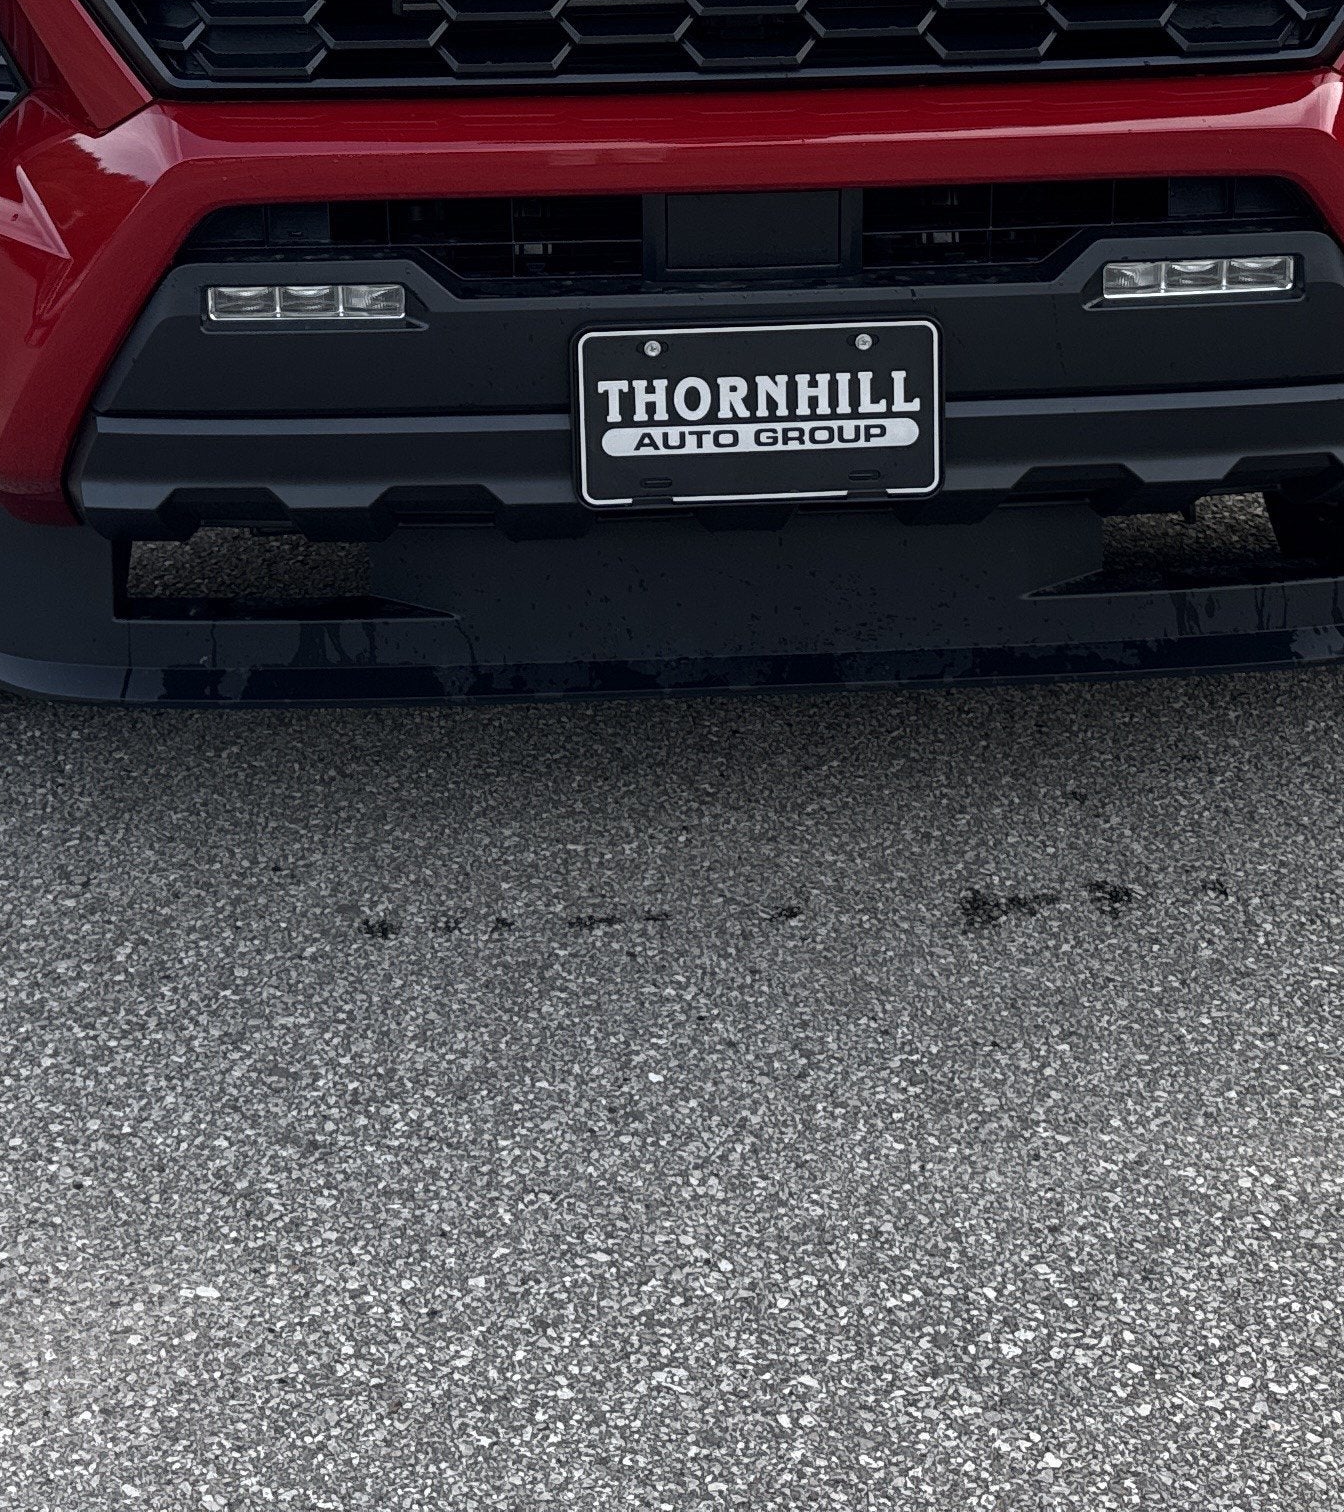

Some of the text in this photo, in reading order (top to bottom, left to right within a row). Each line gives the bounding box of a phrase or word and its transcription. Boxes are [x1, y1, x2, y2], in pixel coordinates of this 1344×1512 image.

[597, 370, 921, 423] THORNHILL
[633, 423, 887, 451] AUTO GROUP
